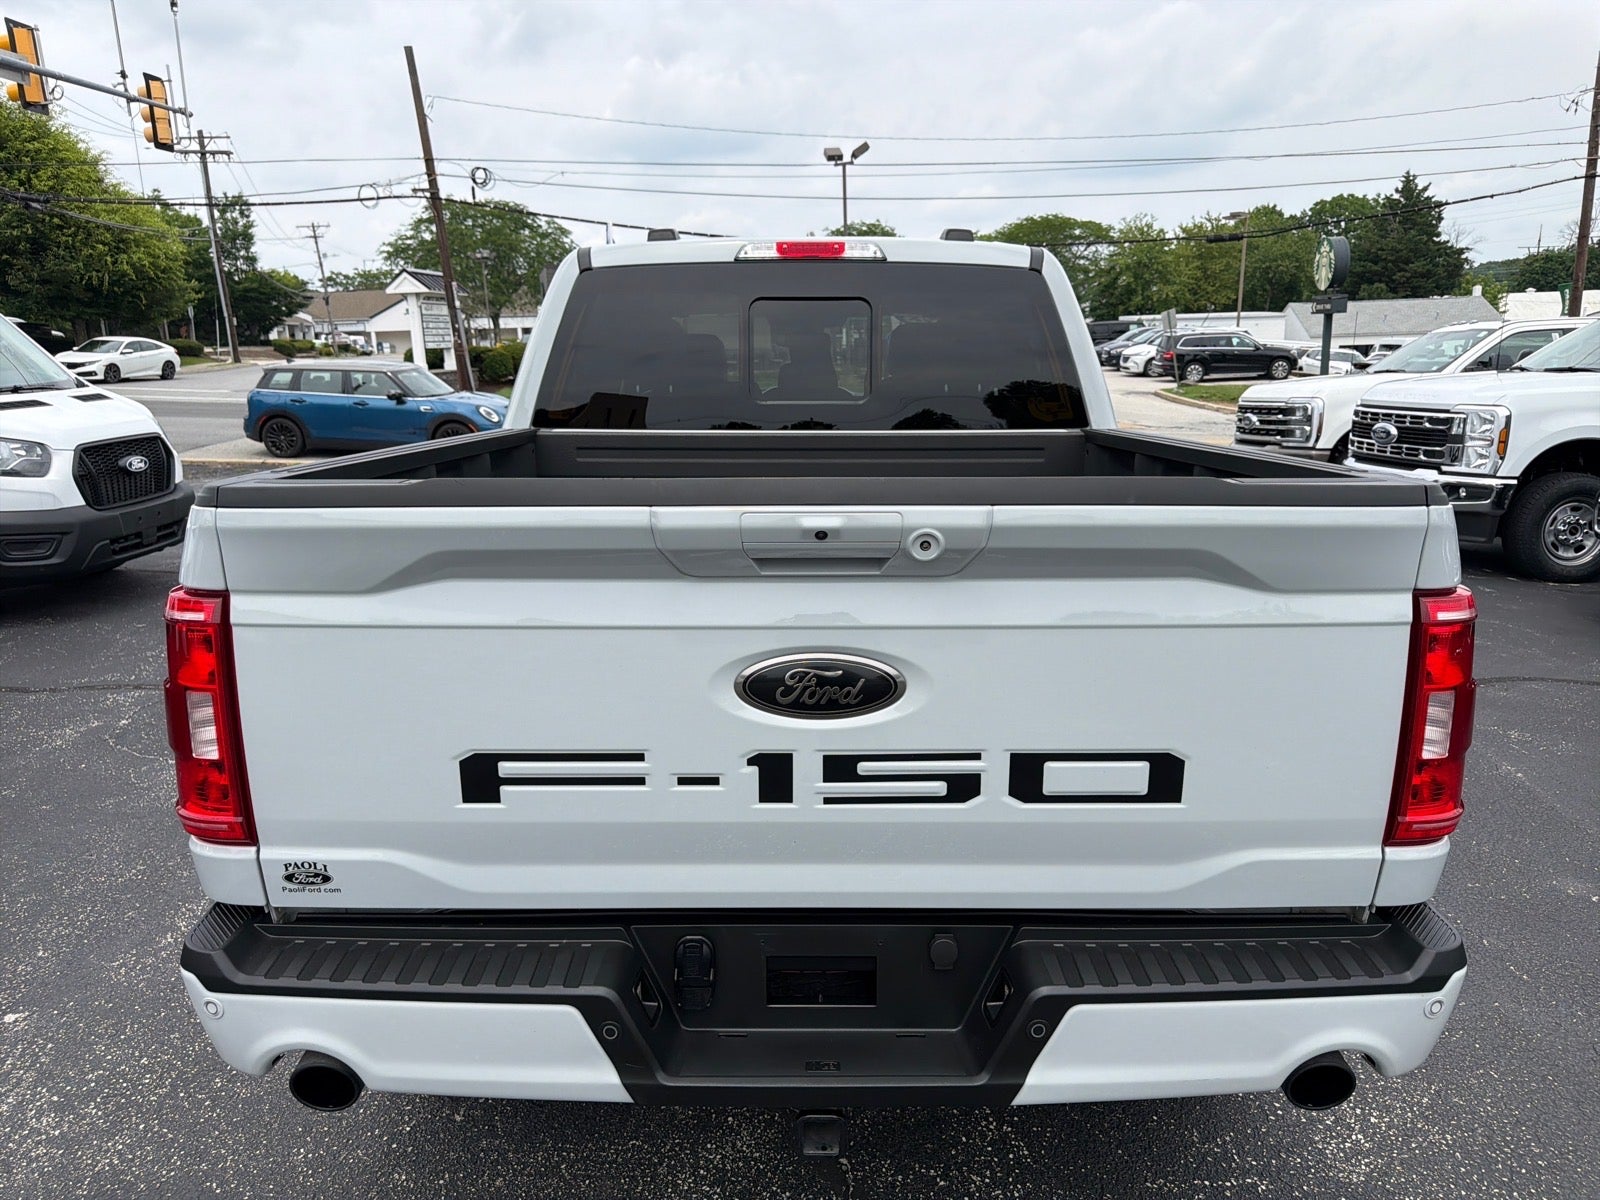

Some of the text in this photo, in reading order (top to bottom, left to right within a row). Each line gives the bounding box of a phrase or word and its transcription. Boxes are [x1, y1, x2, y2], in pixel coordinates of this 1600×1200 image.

[775, 667, 866, 705] Ford
[459, 752, 1185, 804] F-150
[283, 861, 329, 873] PAOLI
[292, 873, 324, 884] Ford
